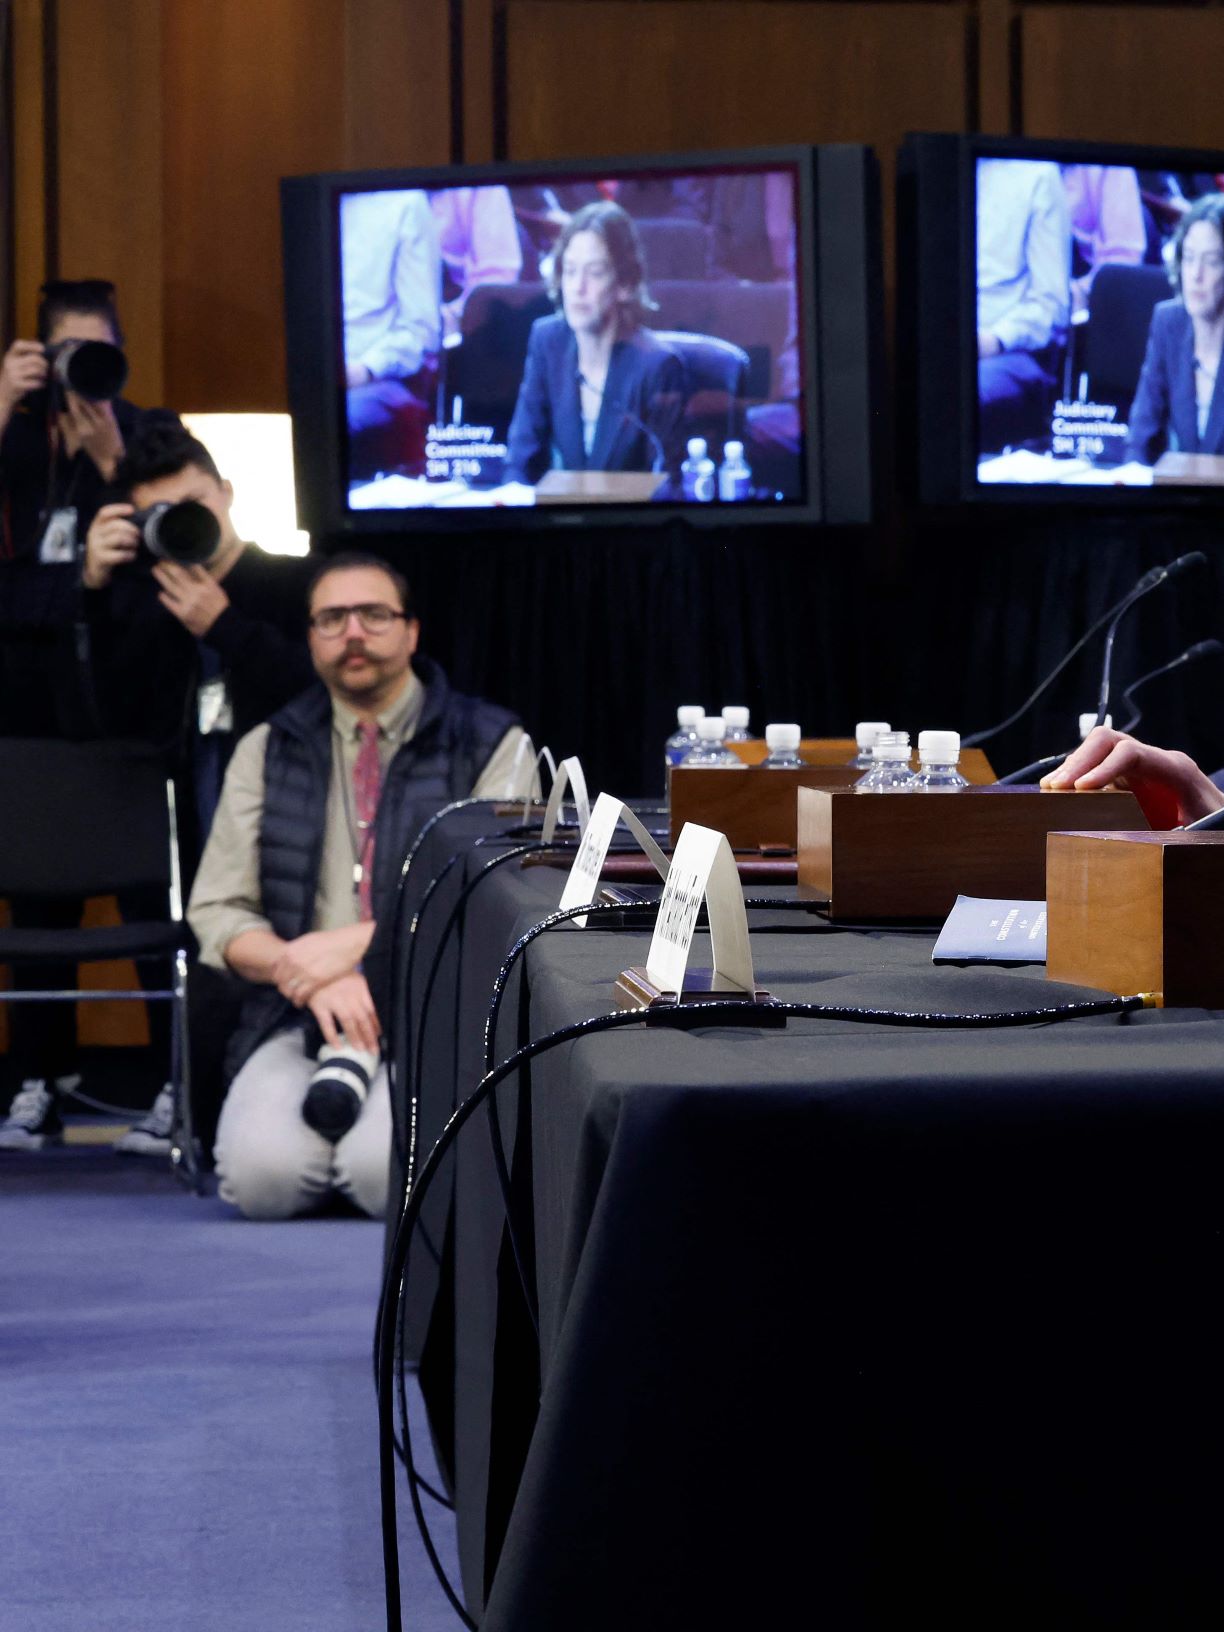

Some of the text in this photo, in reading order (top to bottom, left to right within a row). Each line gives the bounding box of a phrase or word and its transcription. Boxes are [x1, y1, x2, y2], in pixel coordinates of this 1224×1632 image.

[1053, 400, 1117, 422] Judiciary
[426, 424, 494, 443] Judiciary
[1052, 418, 1129, 436] Committee
[425, 441, 508, 459] Committee
